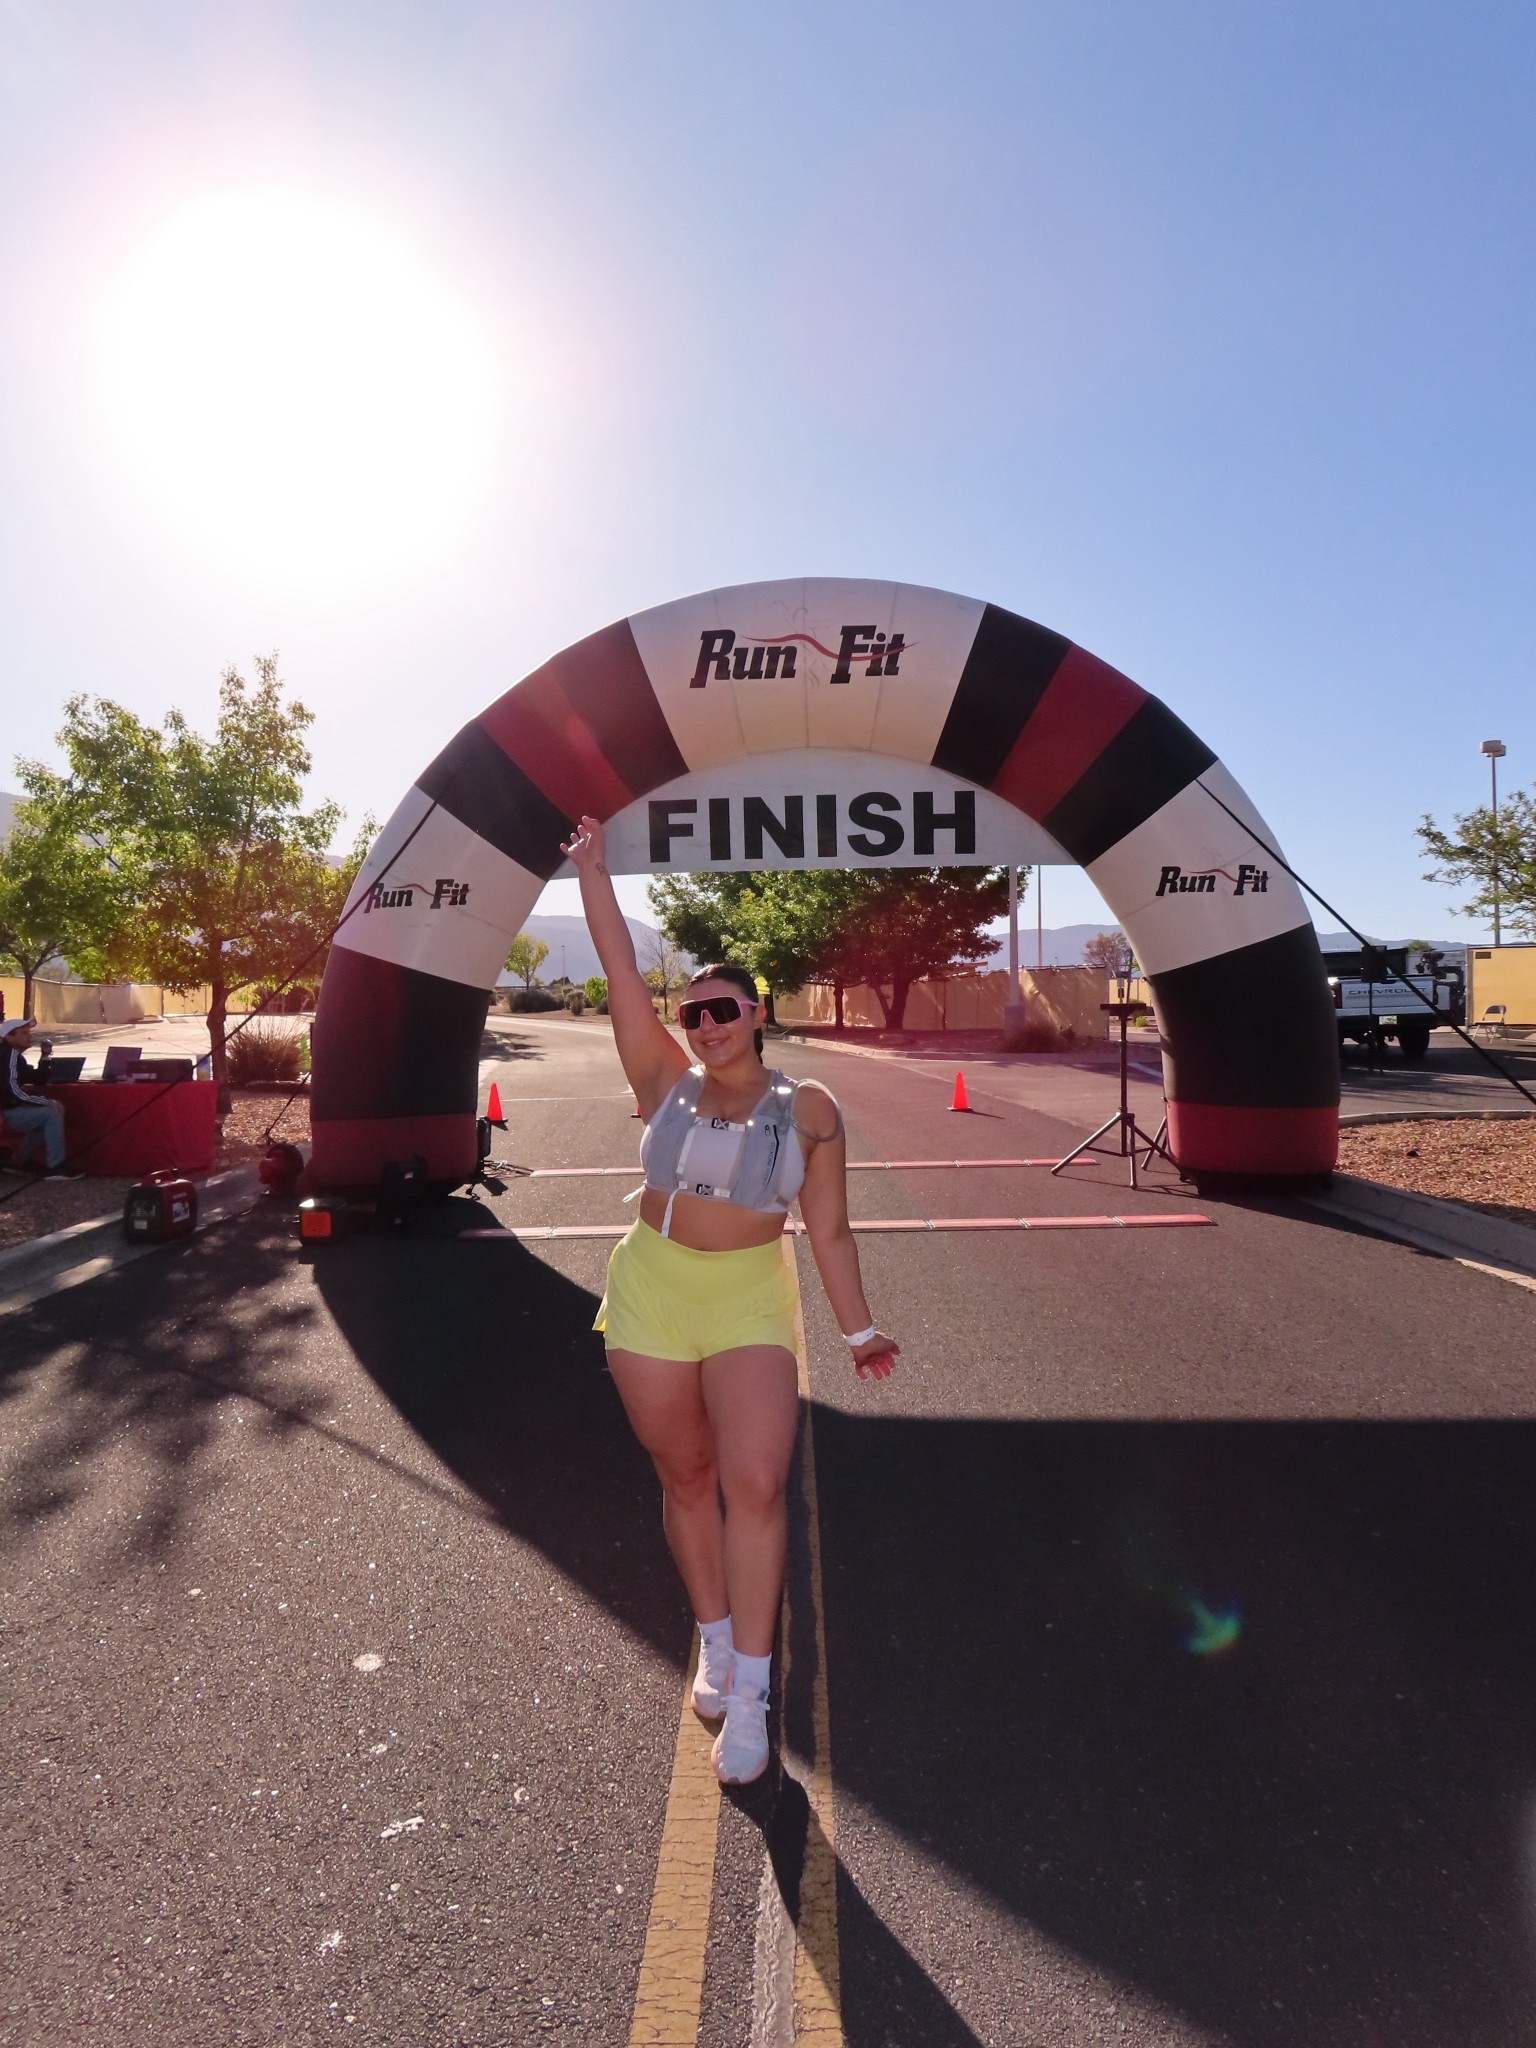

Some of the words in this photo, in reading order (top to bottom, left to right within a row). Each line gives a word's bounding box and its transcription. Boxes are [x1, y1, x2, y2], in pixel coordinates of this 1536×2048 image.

[689, 629, 797, 688] Run
[830, 625, 905, 684] Fit
[648, 790, 976, 863] FINISH
[364, 882, 413, 913] Run
[430, 879, 470, 908] Fit
[1156, 866, 1215, 896] Run
[1233, 865, 1268, 895] Fit
[1348, 987, 1427, 995] CHEVROLT
